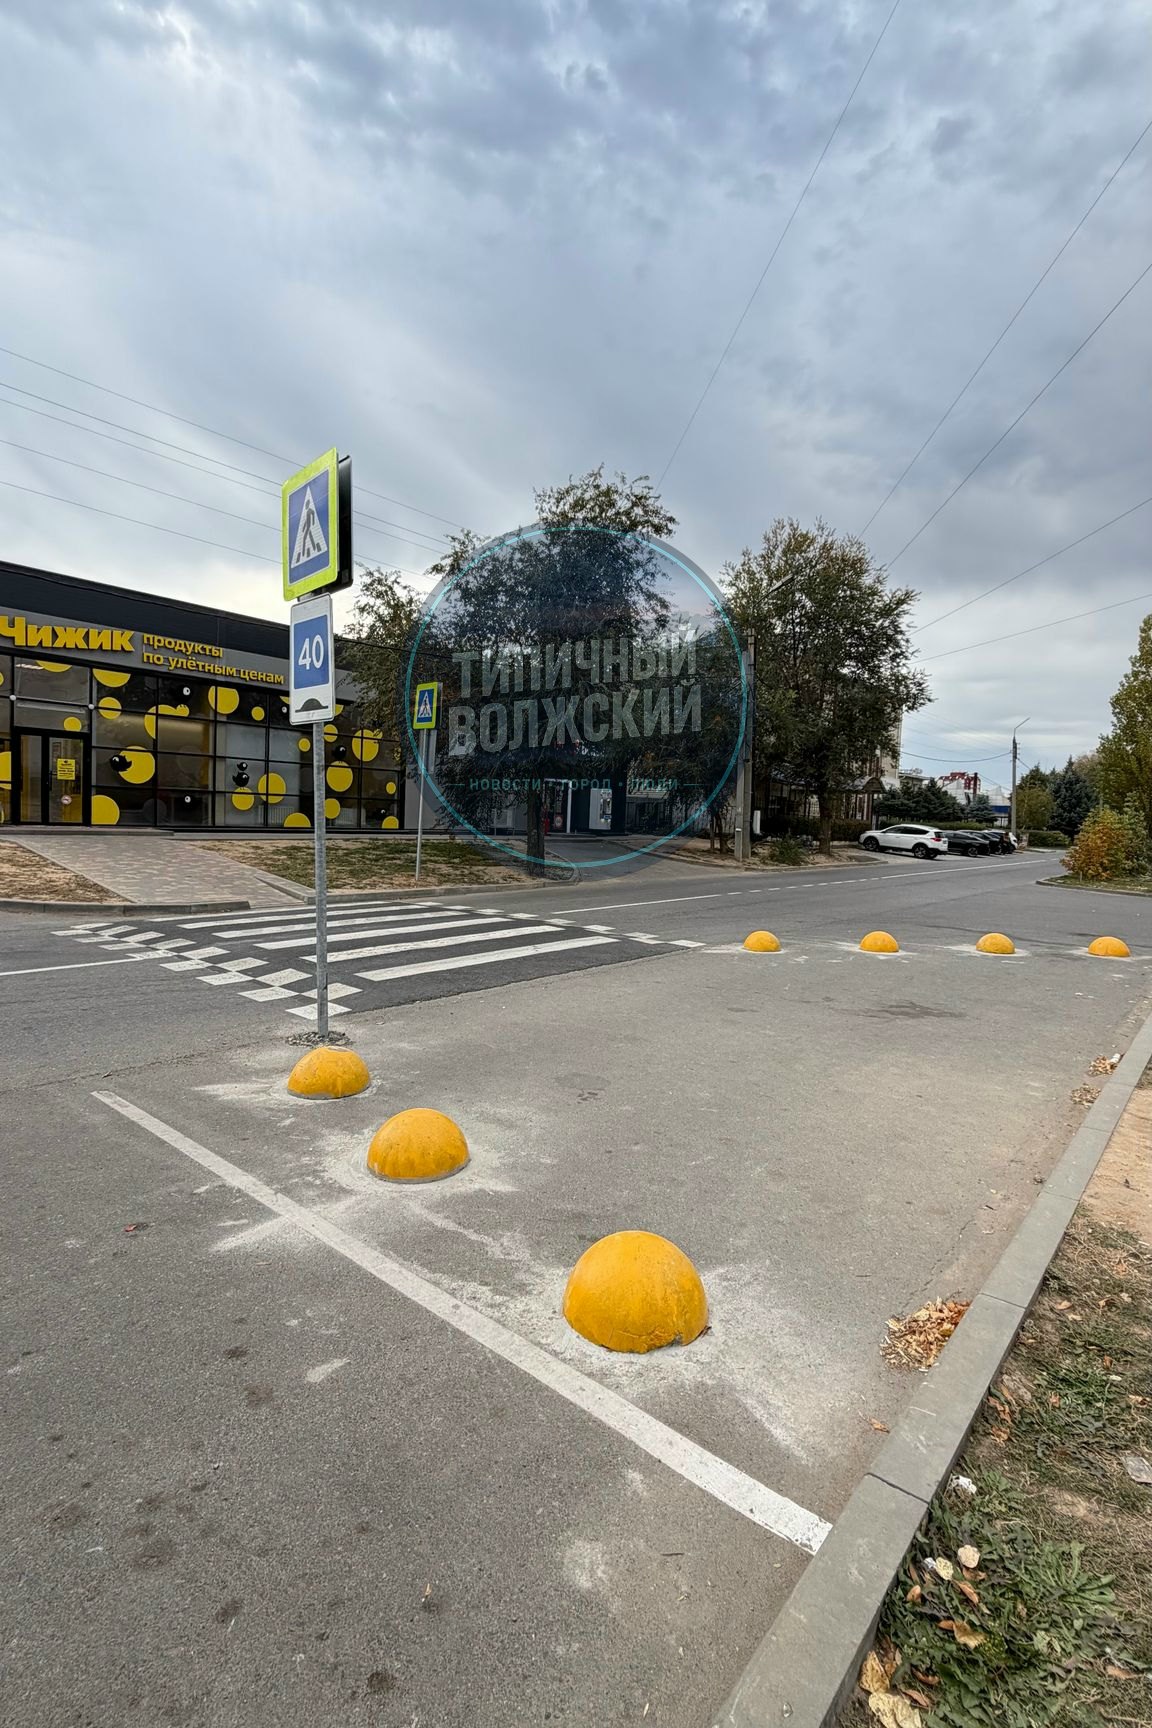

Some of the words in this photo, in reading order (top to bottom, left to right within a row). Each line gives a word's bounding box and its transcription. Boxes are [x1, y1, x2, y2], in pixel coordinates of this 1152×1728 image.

[0, 615, 135, 652] Чижик
[142, 632, 223, 658] продукты
[142, 652, 164, 665] по
[168, 655, 237, 677] улётным
[239, 668, 284, 684] ценам
[298, 634, 325, 670] 40
